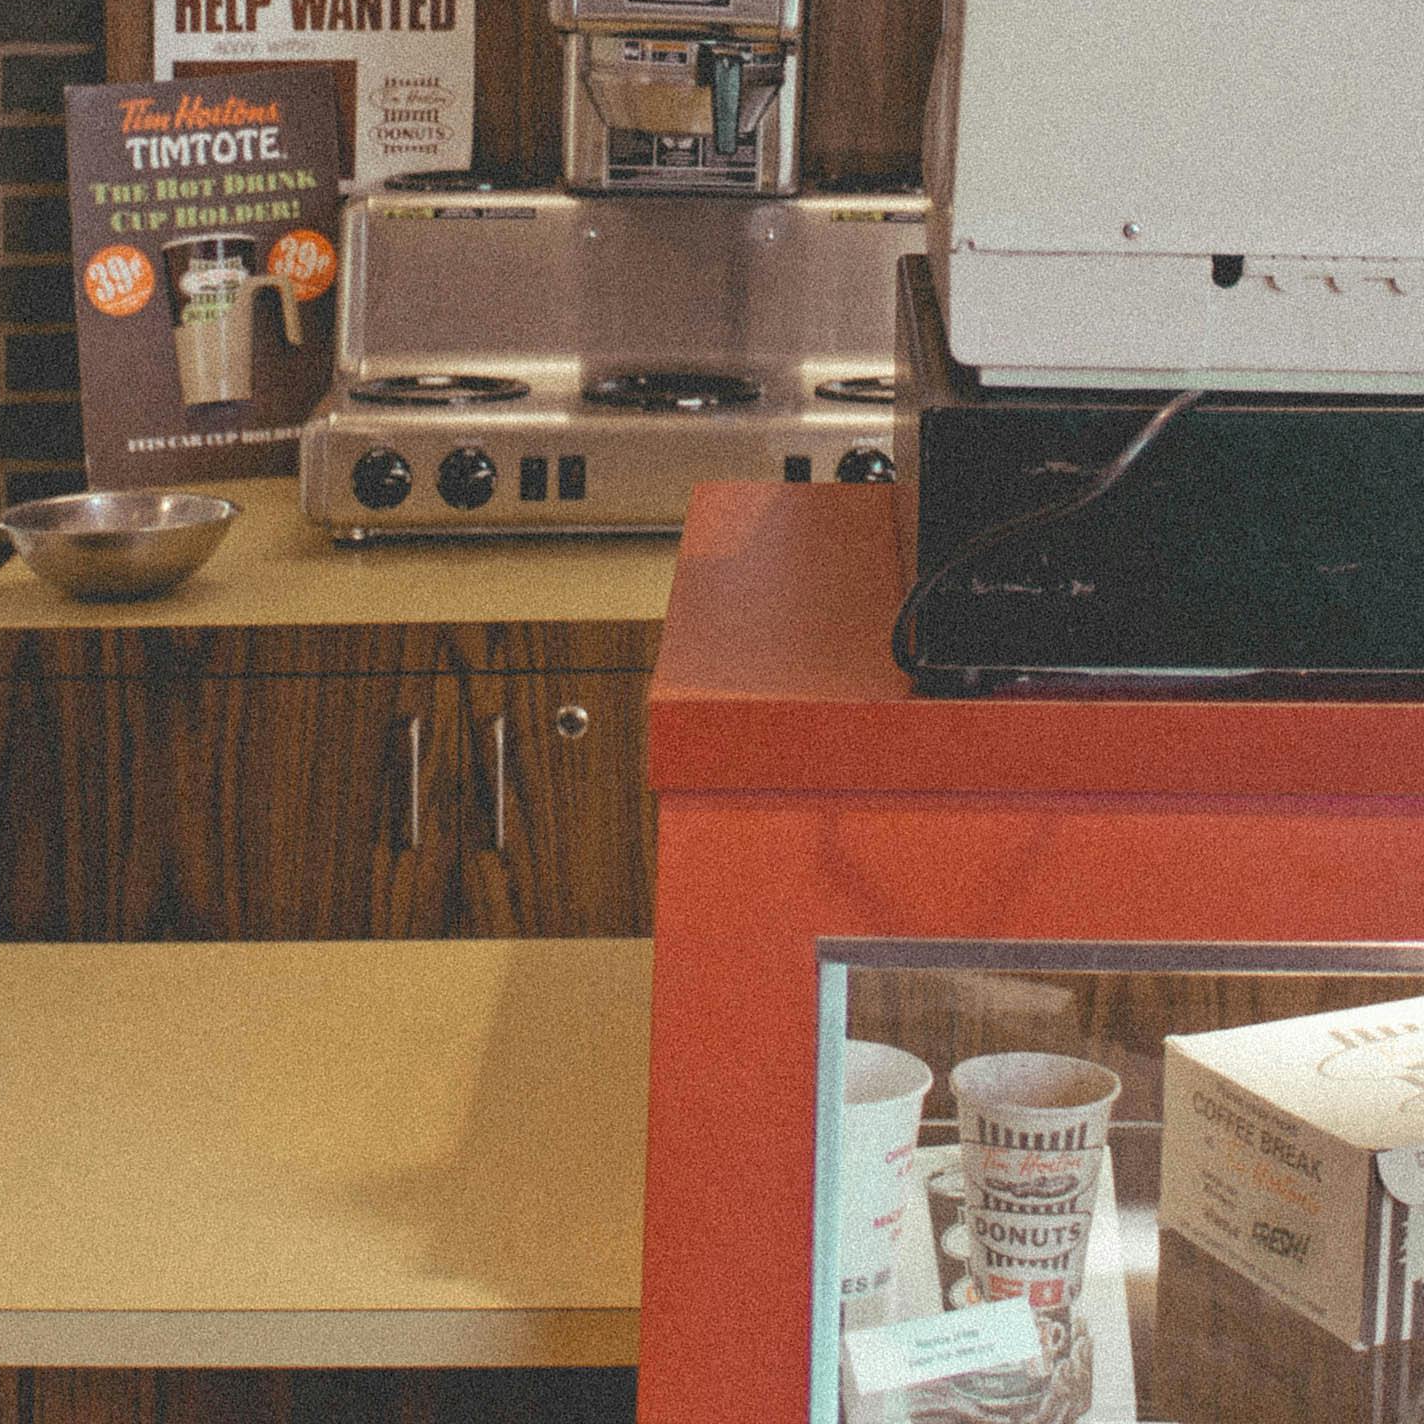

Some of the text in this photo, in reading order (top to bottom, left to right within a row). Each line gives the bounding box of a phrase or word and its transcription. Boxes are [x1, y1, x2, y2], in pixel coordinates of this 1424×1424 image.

[118, 95, 170, 134] Tim
[1193, 1090, 1256, 1146] COFFEE
[1259, 1129, 1323, 1184] BREAK
[975, 1219, 1082, 1249] DONUTS
